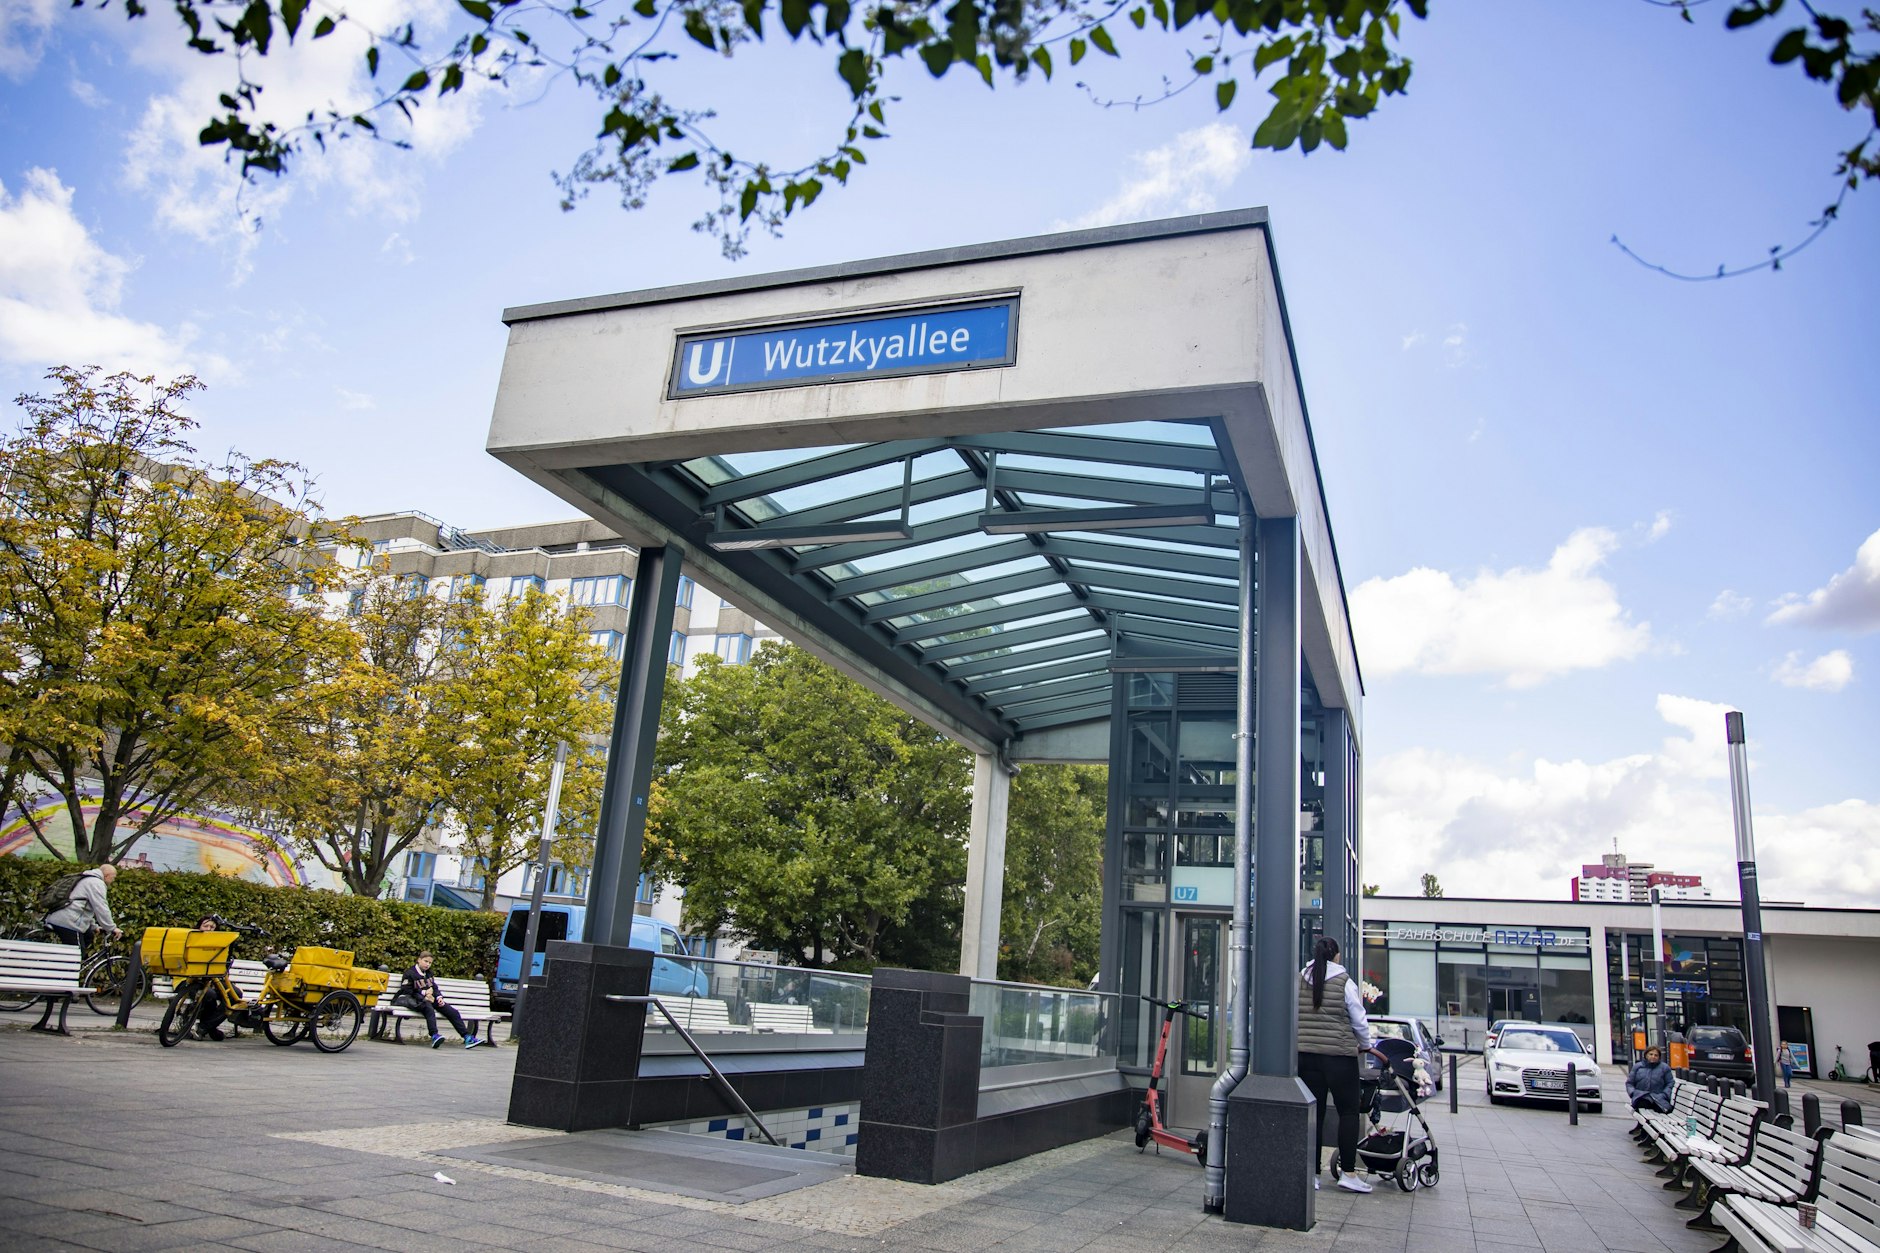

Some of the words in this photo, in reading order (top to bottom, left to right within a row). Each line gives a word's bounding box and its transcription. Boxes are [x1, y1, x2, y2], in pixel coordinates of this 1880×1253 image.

[688, 341, 726, 385] U
[764, 322, 971, 371] Wutzkyallee
[1177, 888, 1196, 900] U7
[1397, 928, 1492, 943] FAHRSCHULE
